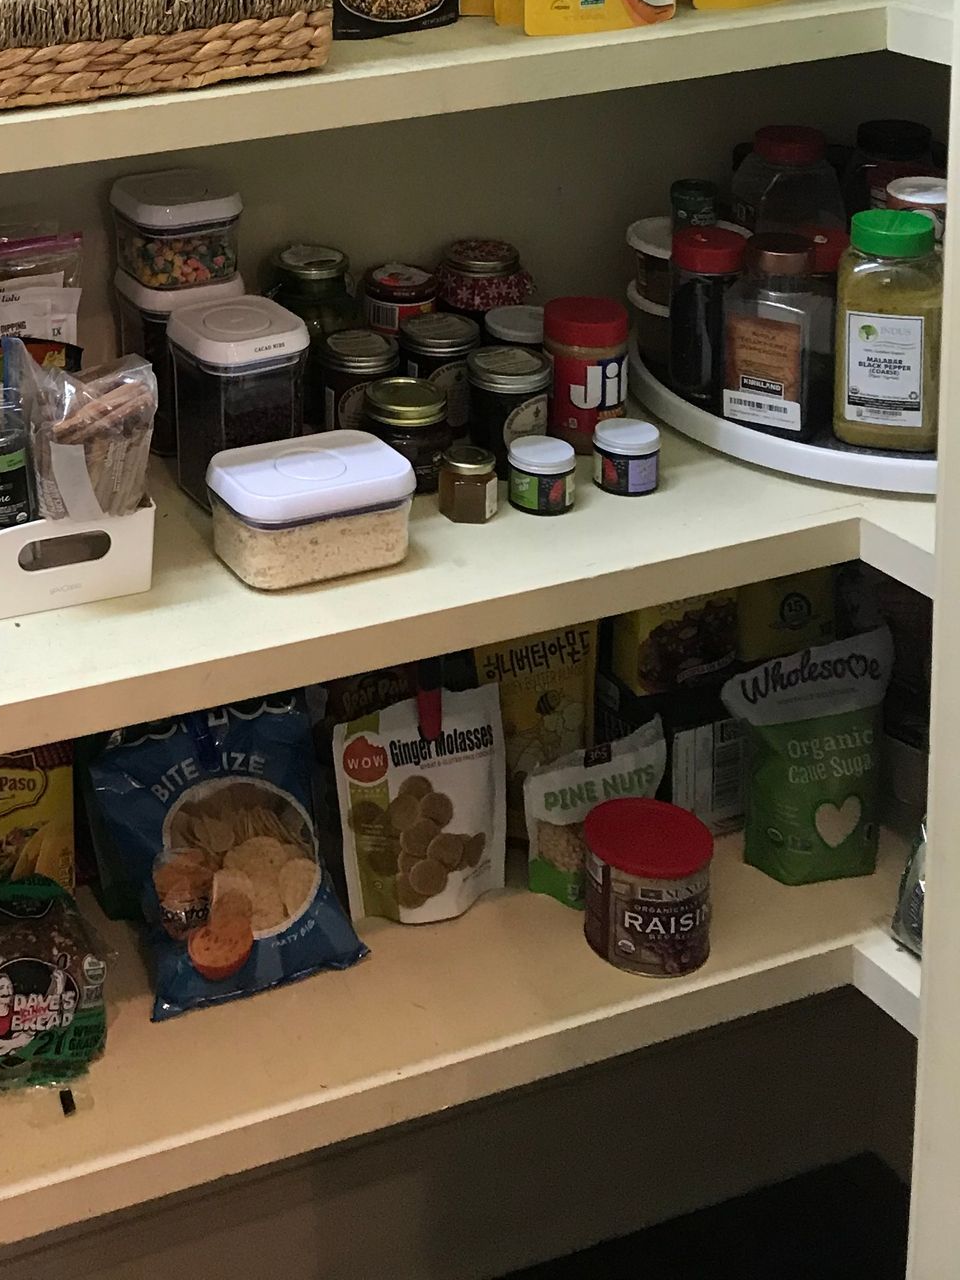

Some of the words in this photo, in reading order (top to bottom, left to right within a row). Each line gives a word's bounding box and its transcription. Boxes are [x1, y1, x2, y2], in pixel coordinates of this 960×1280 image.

[0, 320, 27, 332] DIPPING
[858, 361, 881, 369] BLACK
[884, 363, 912, 371] PEPPER
[866, 356, 903, 365] MALABAR
[389, 733, 434, 768] Ginger
[788, 726, 874, 760] Organic
[348, 754, 384, 770] WOW
[788, 762, 827, 784] Cane
[150, 756, 200, 804] BITE
[212, 751, 266, 775] IZE
[543, 779, 598, 812] PINE
[602, 764, 656, 797] NUTS
[12, 990, 76, 1013] DAVE'S
[10, 1013, 74, 1032] BREAD
